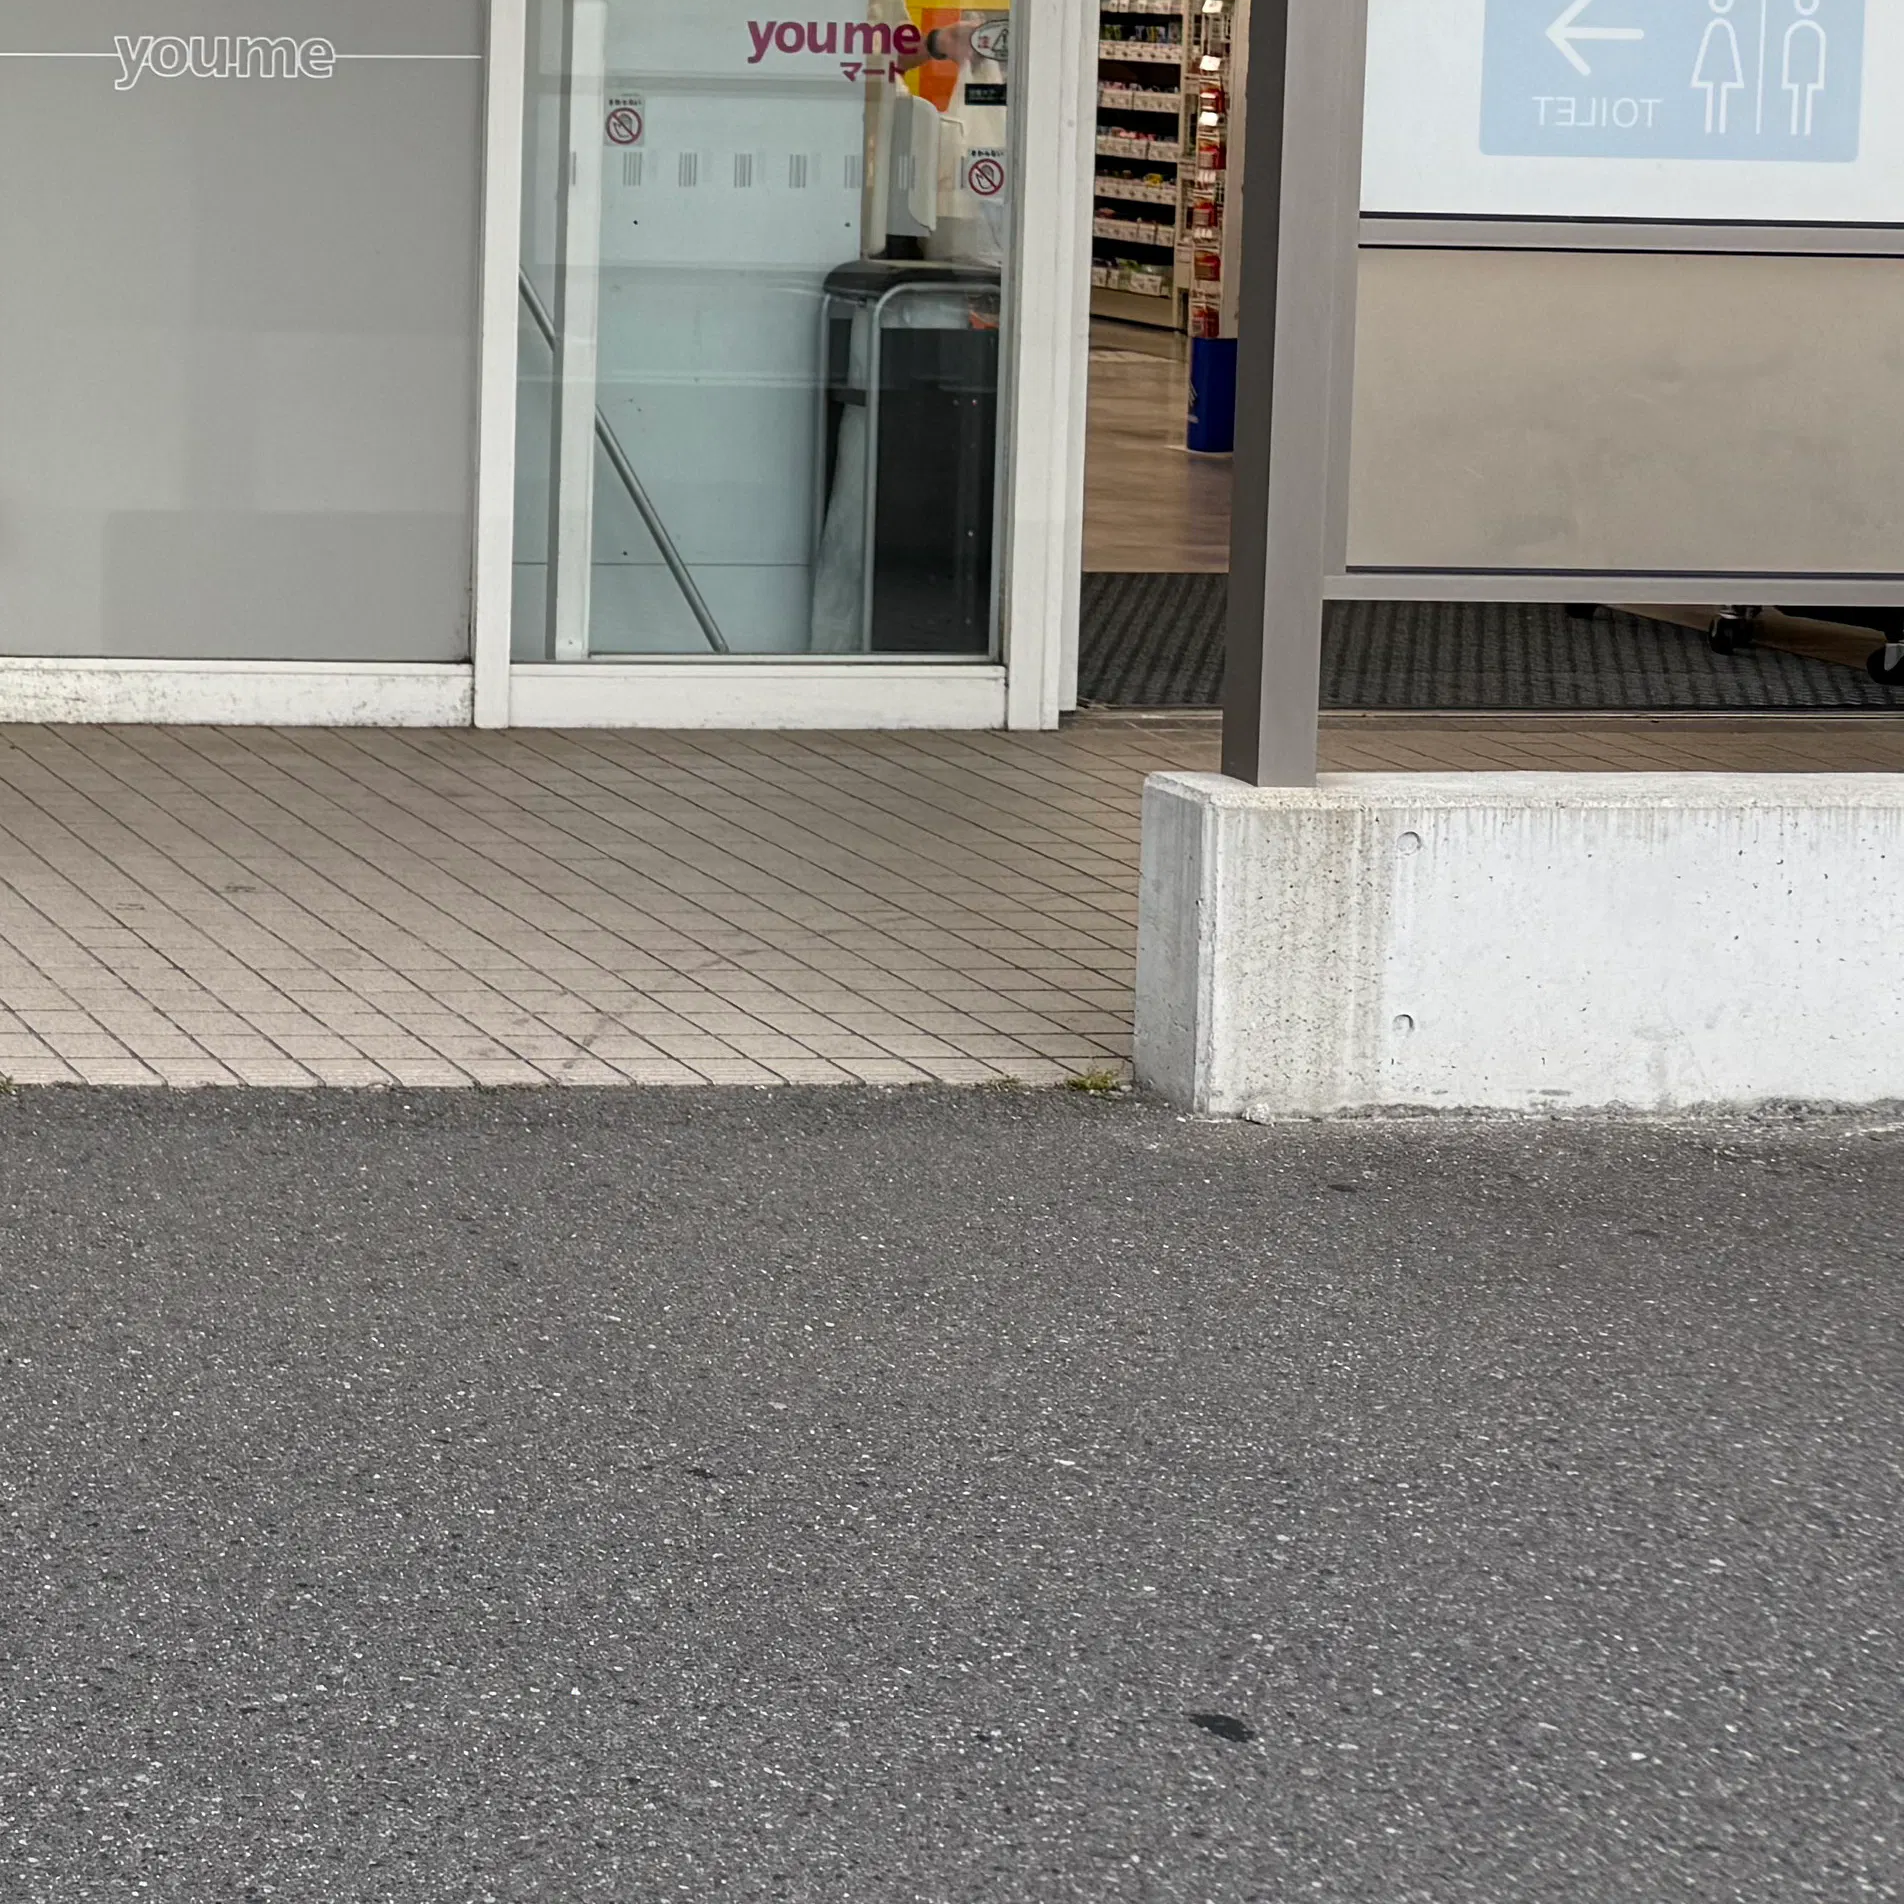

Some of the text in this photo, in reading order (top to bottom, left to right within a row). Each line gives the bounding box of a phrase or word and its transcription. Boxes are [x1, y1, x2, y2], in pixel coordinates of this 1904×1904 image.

[114, 36, 336, 90] youme
[747, 21, 921, 64] youme
[840, 61, 907, 83] マート
